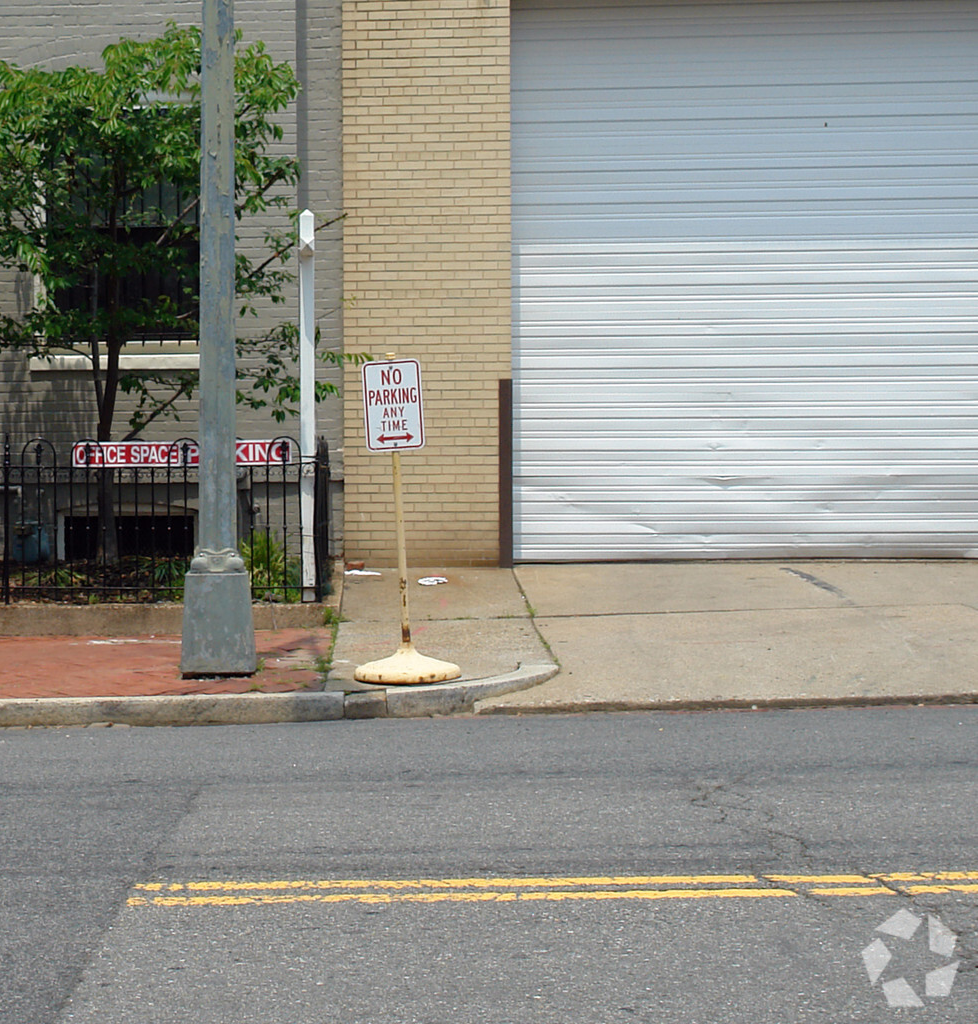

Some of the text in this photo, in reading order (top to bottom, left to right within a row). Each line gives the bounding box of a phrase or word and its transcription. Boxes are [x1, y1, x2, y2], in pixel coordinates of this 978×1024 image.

[381, 368, 402, 386] NO
[369, 387, 417, 406] PARKING
[383, 406, 405, 419] ANY
[381, 419, 408, 432] TIME
[130, 445, 178, 464] SPACE
[187, 443, 289, 463] PKING
